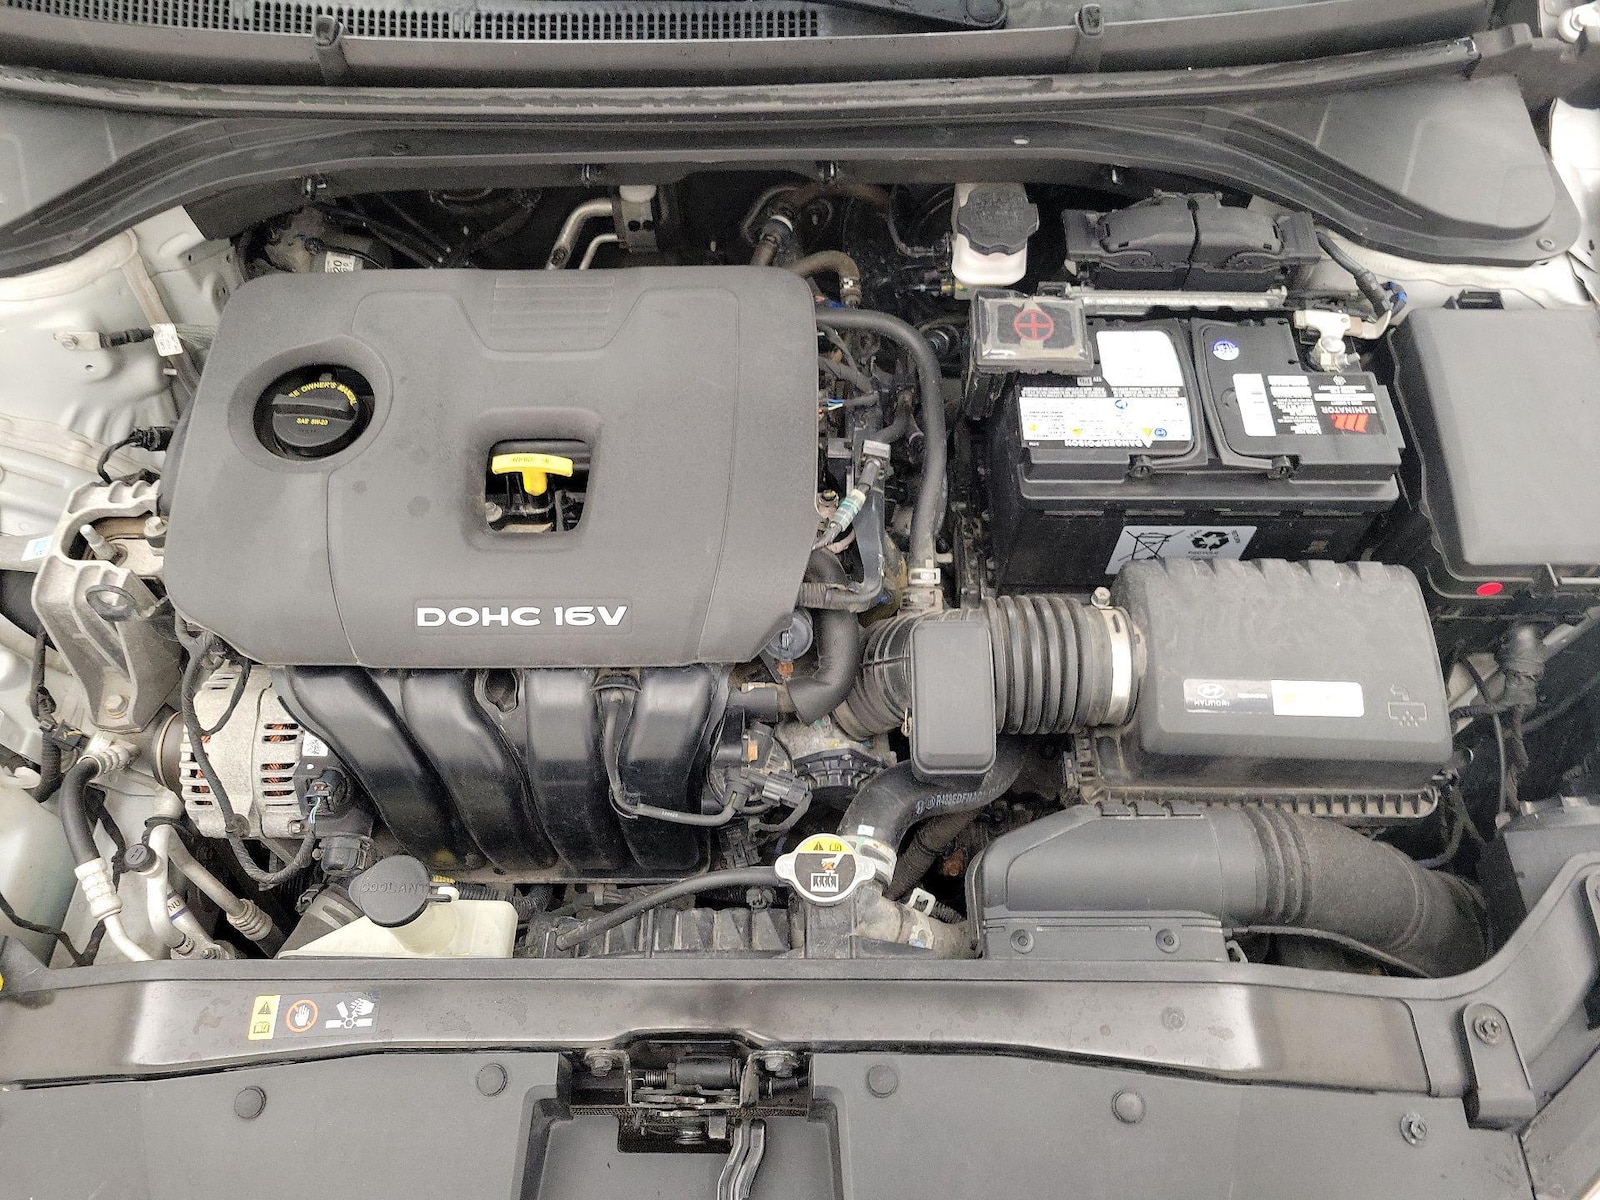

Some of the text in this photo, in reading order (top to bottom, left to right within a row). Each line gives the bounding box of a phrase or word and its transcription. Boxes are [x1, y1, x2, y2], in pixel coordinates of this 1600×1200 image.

[301, 381, 338, 393] OWNER'S
[1319, 405, 1377, 415] ELIMINATOR
[416, 606, 629, 628] DOHC 16V
[1192, 699, 1231, 708] HYUNDAI
[361, 880, 430, 895] COOLANT
